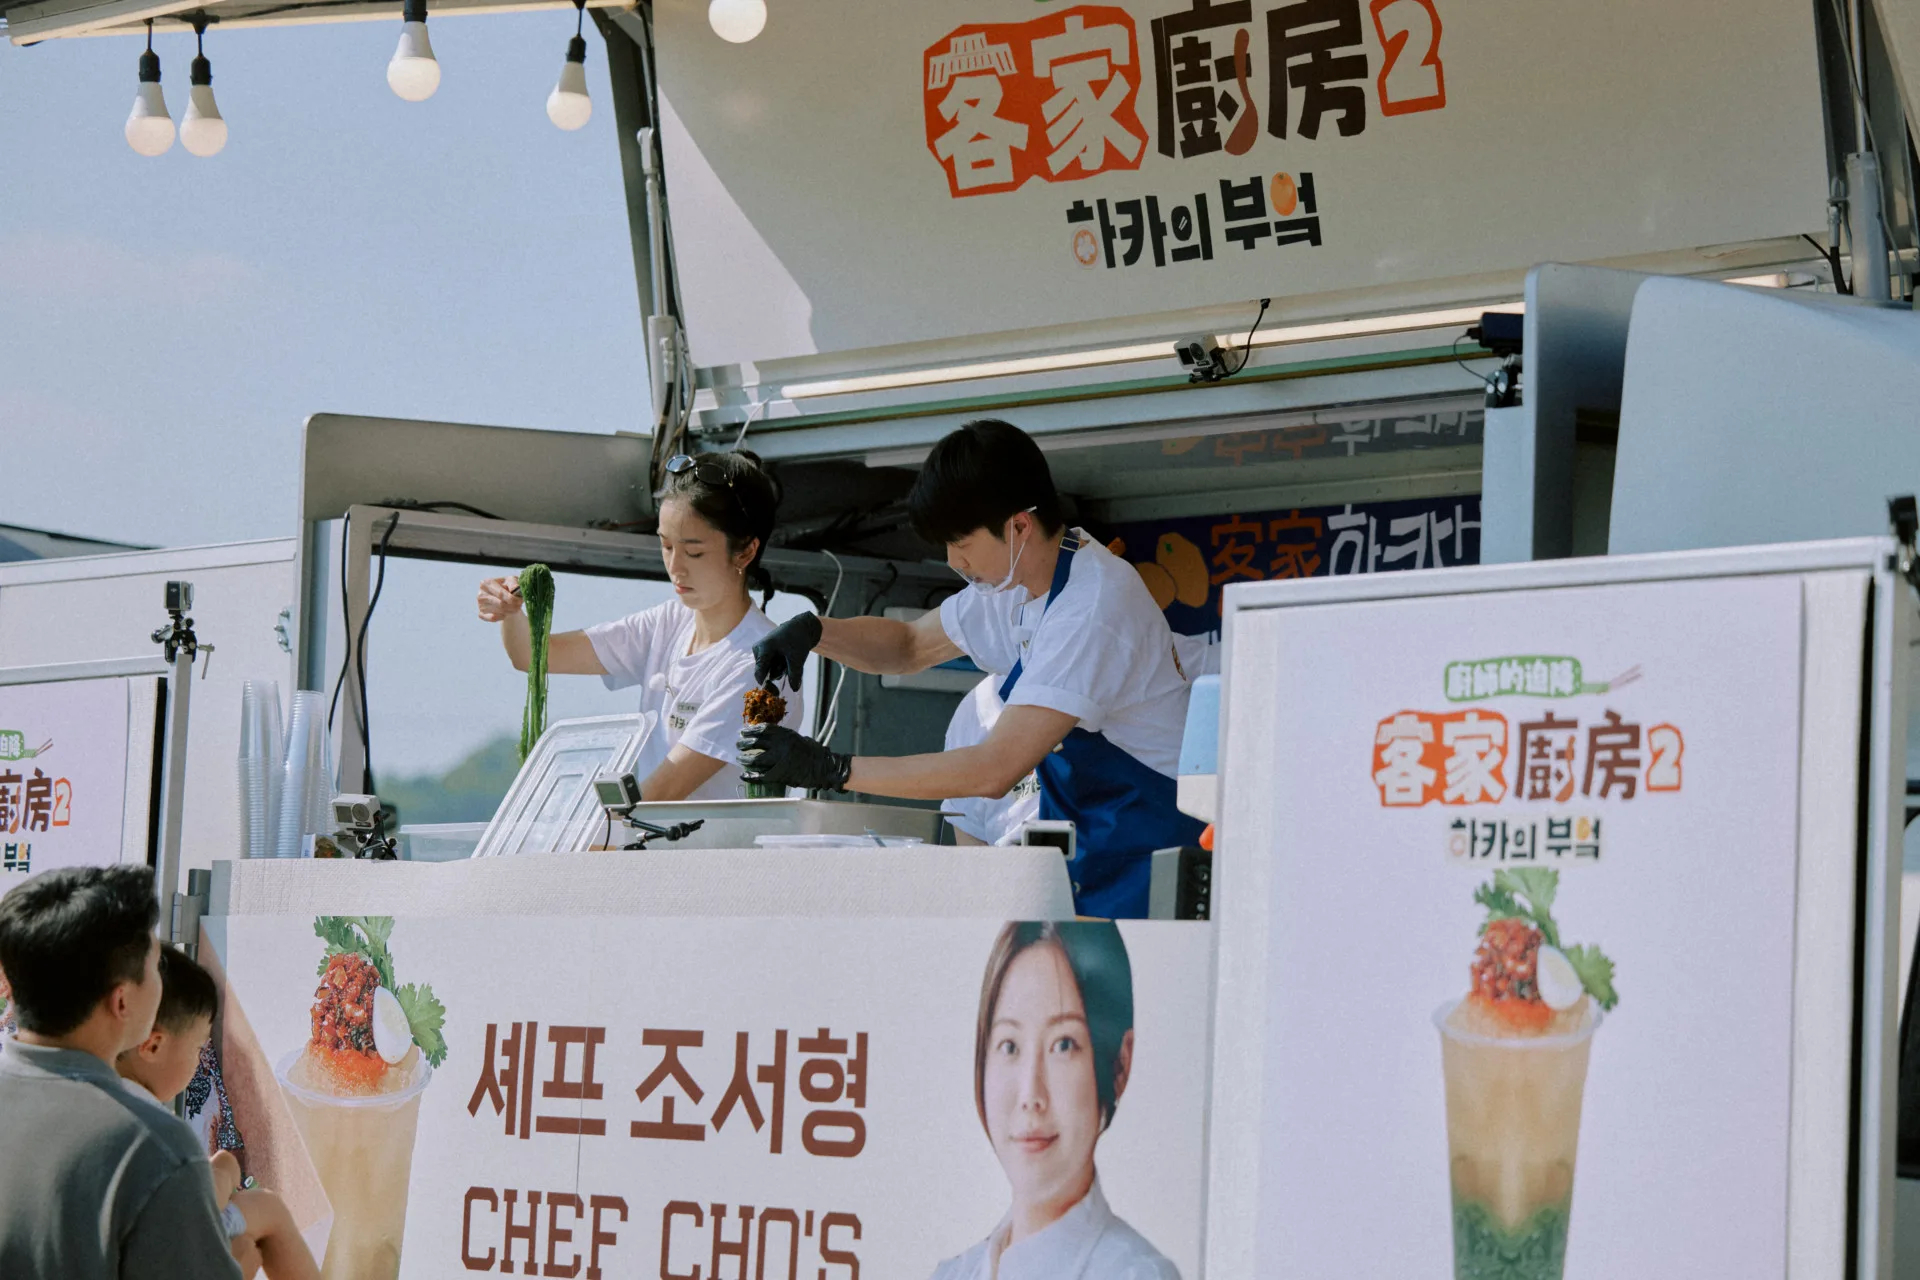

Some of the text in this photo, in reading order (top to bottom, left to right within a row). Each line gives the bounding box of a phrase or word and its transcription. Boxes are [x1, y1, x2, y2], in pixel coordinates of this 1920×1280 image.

[1066, 172, 1322, 268] 하카의 부엌
[1451, 814, 1601, 861] 하카의 부엌
[467, 1021, 868, 1158] 셰프 조서형
[461, 1186, 862, 1280] CHEF CHO'S
